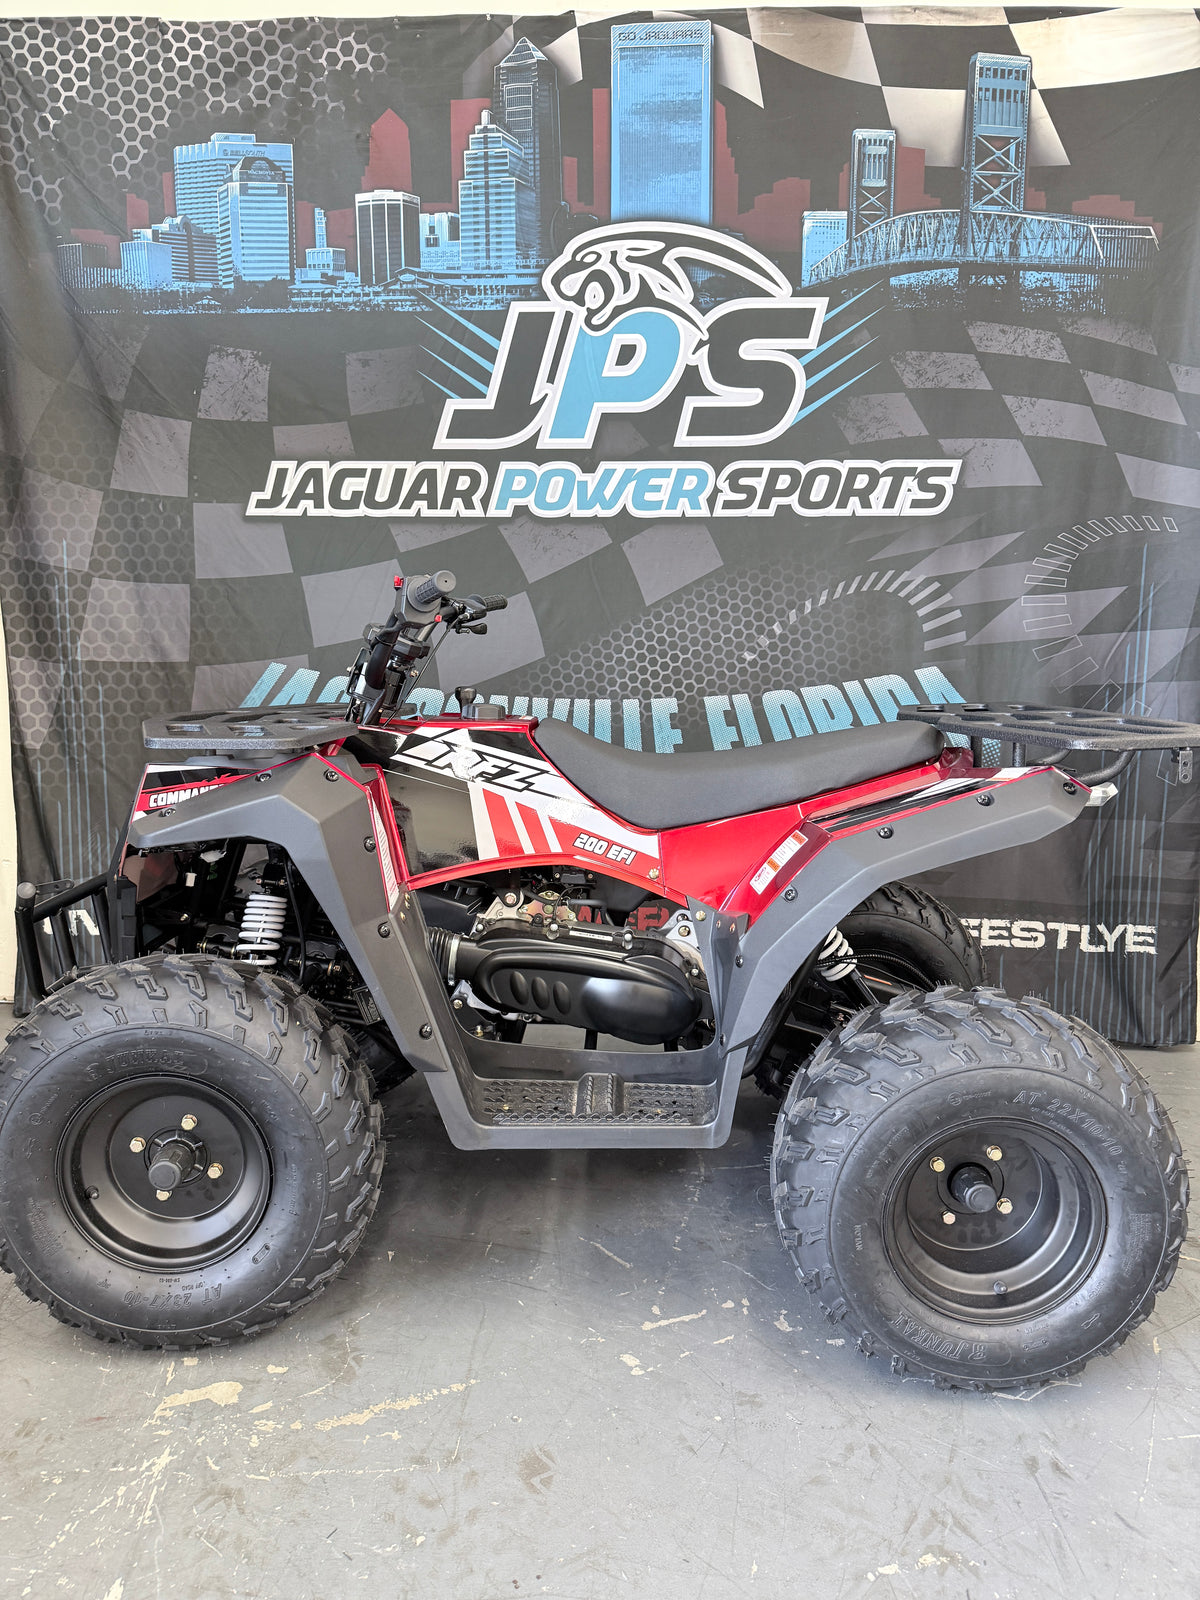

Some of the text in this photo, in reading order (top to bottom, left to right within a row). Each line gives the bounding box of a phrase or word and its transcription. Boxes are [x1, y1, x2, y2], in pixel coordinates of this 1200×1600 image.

[618, 29, 703, 41] GO JAGUARS
[433, 297, 829, 450] JPS
[246, 460, 487, 517] JAGUAR
[712, 459, 963, 517] SPORTS
[572, 832, 637, 866] 200 EFI
[1013, 1090, 1042, 1106] AT
[1047, 1098, 1123, 1156] 22X10-10
[201, 1282, 222, 1306] AT
